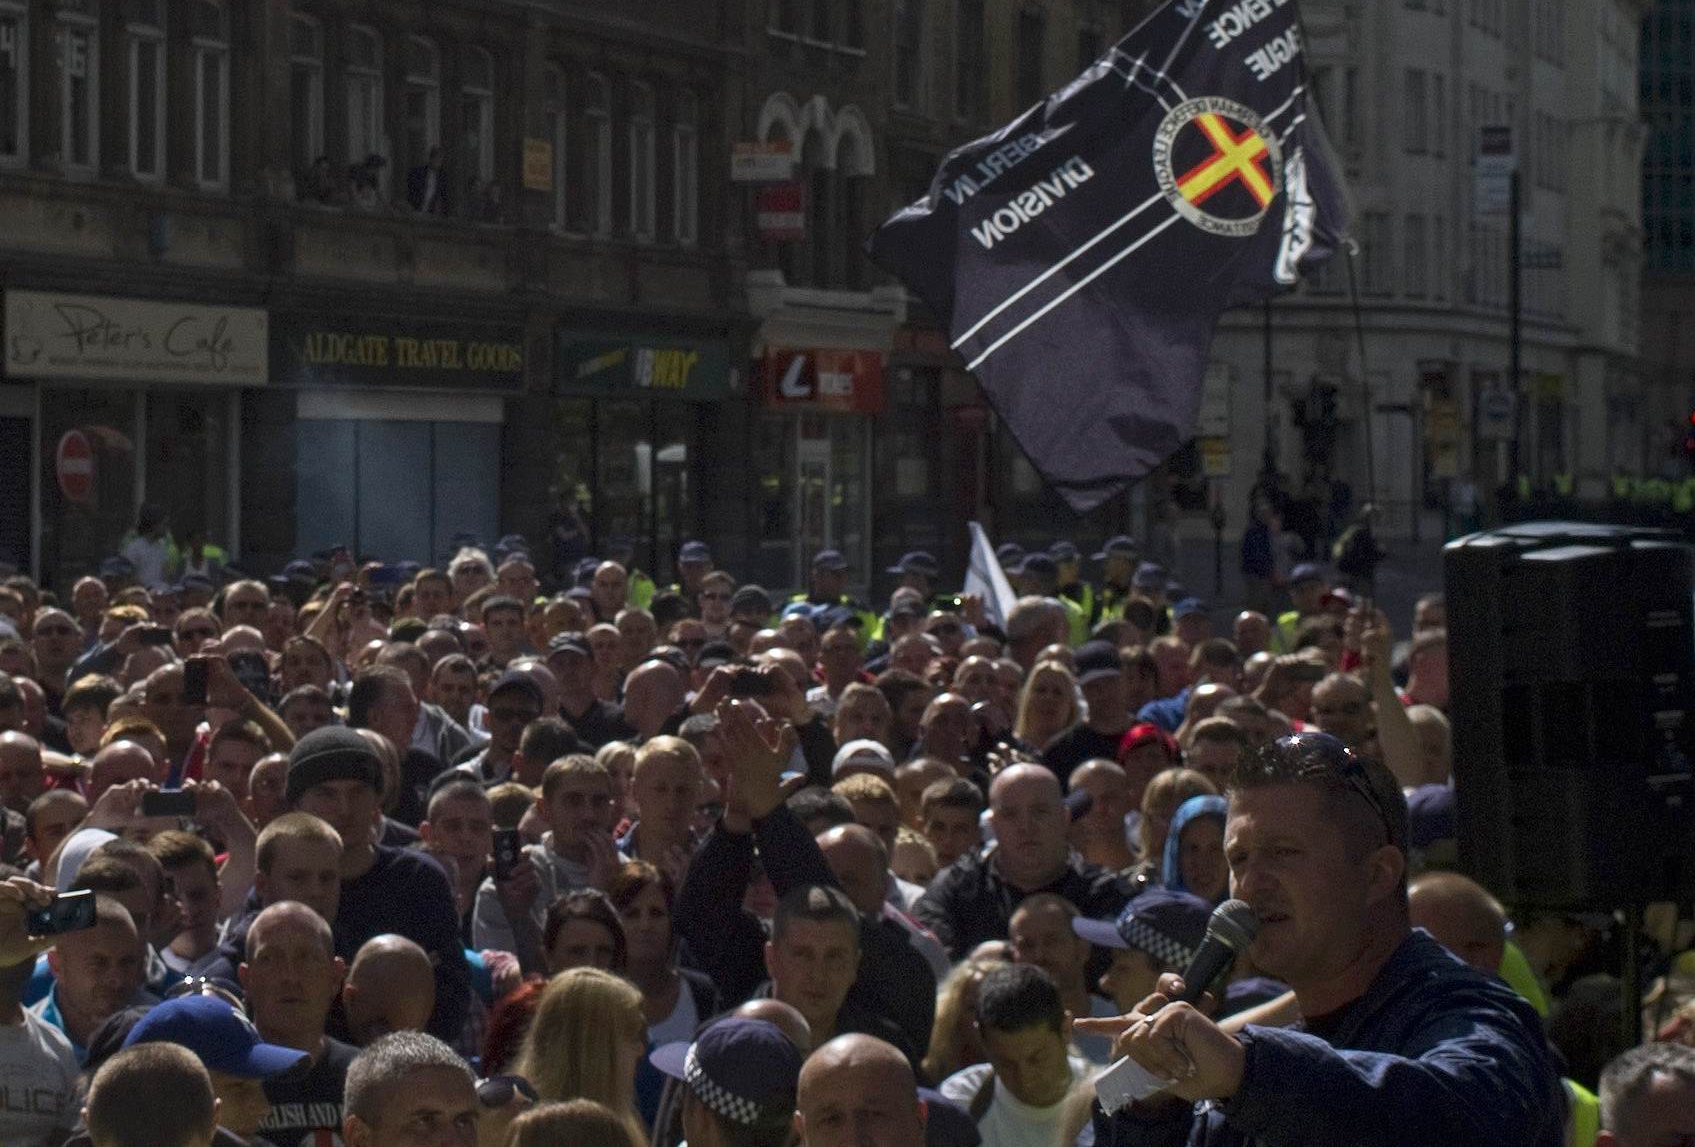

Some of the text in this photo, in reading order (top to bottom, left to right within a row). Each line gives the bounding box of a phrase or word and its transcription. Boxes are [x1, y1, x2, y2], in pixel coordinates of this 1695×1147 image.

[303, 332, 389, 367] ALDGATE
[394, 336, 463, 370] TRAVEL
[466, 340, 522, 373] GOODS
